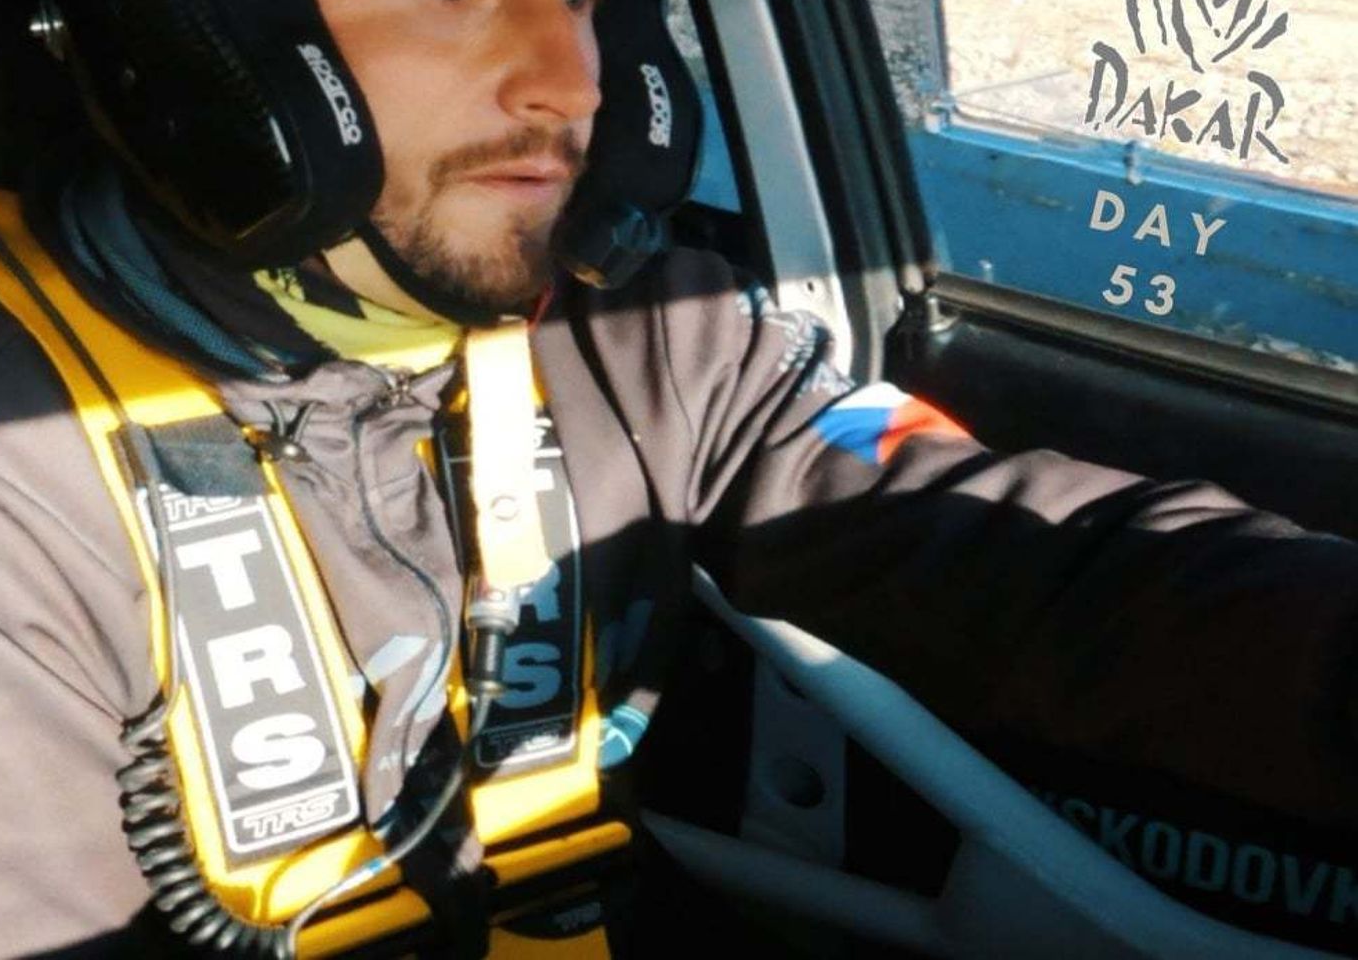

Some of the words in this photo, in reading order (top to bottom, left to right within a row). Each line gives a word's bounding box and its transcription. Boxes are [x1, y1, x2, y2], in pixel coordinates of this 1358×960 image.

[296, 43, 362, 146] sparco
[176, 529, 326, 790] TRS
[243, 791, 341, 838] TRS
